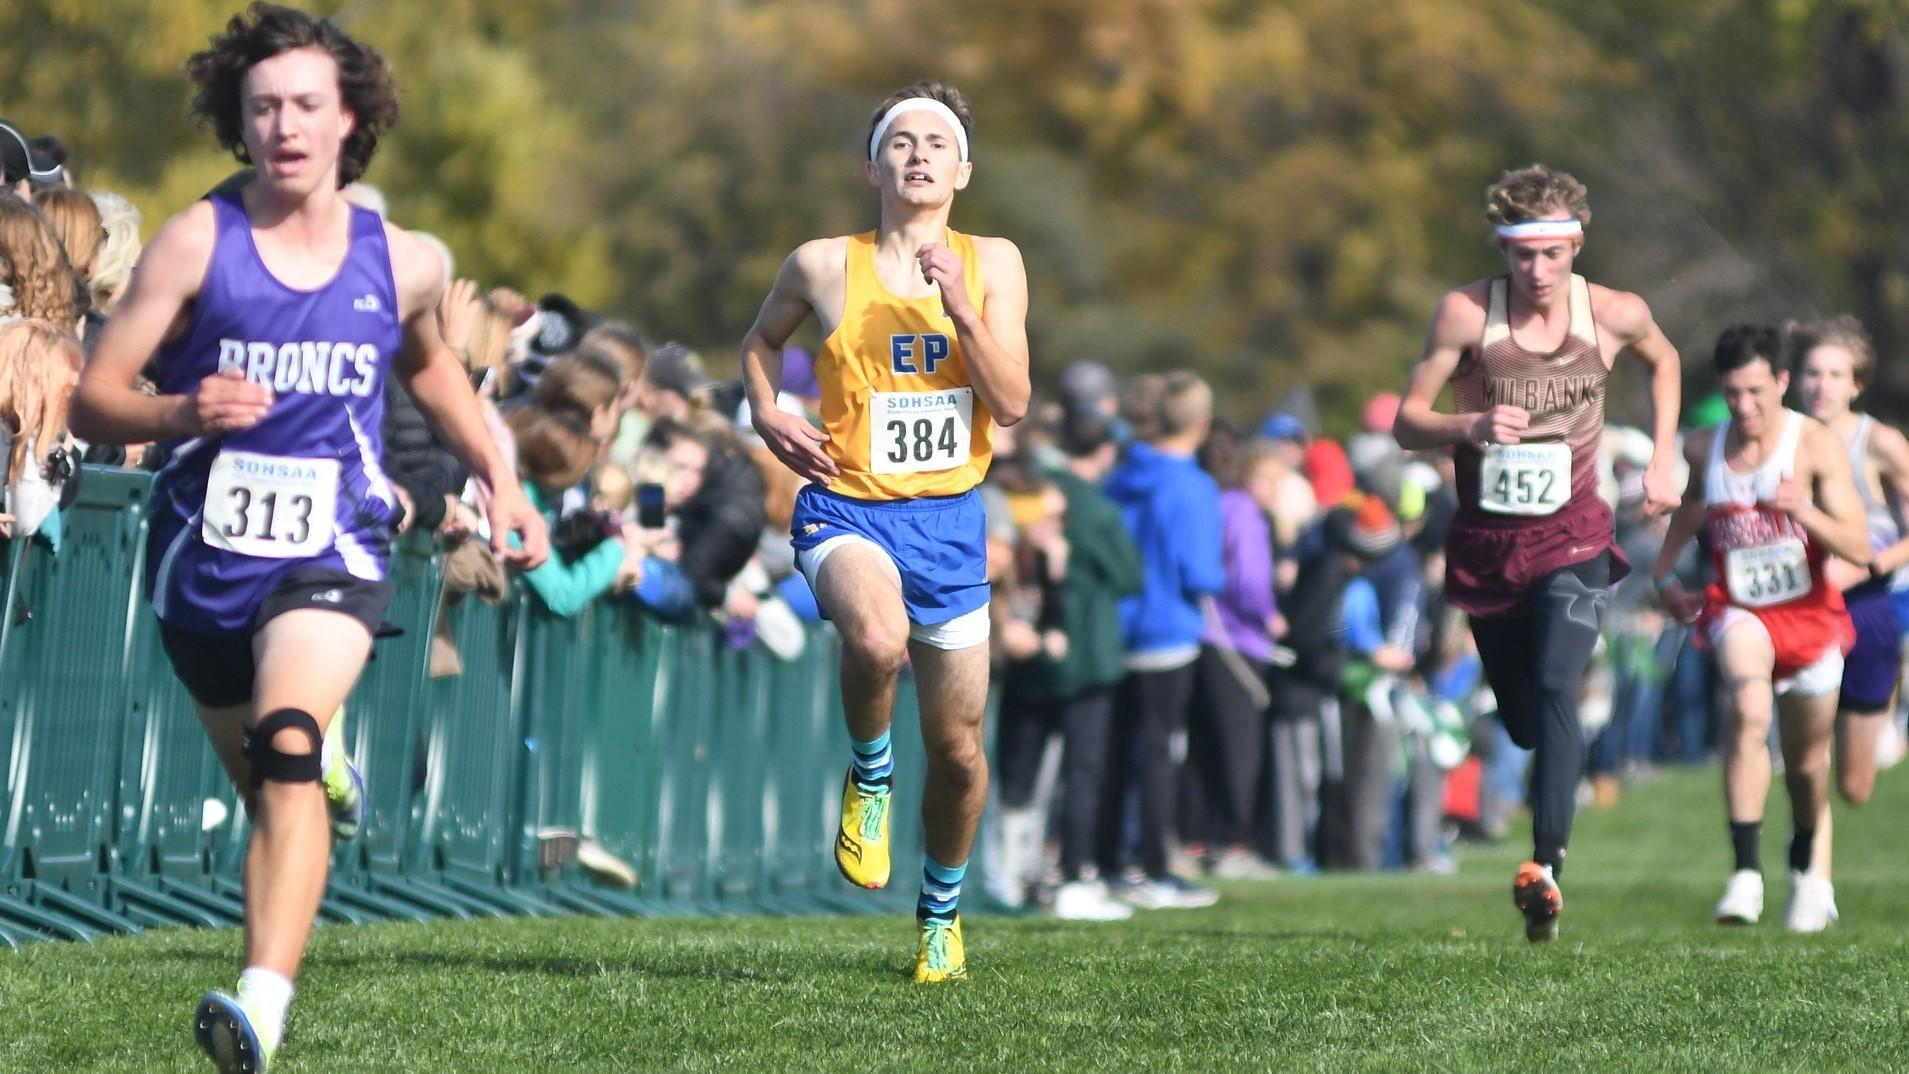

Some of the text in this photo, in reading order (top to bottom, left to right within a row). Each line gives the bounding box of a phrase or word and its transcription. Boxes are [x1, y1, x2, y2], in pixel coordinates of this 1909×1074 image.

[217, 338, 378, 397] BRONCS
[890, 333, 949, 375] EP
[887, 394, 957, 409] SDHSAA
[1480, 375, 1597, 413] MILBANK
[886, 416, 958, 463] 384
[233, 457, 317, 480] SDHSAA
[1493, 469, 1555, 504] 452
[222, 486, 313, 544] 313
